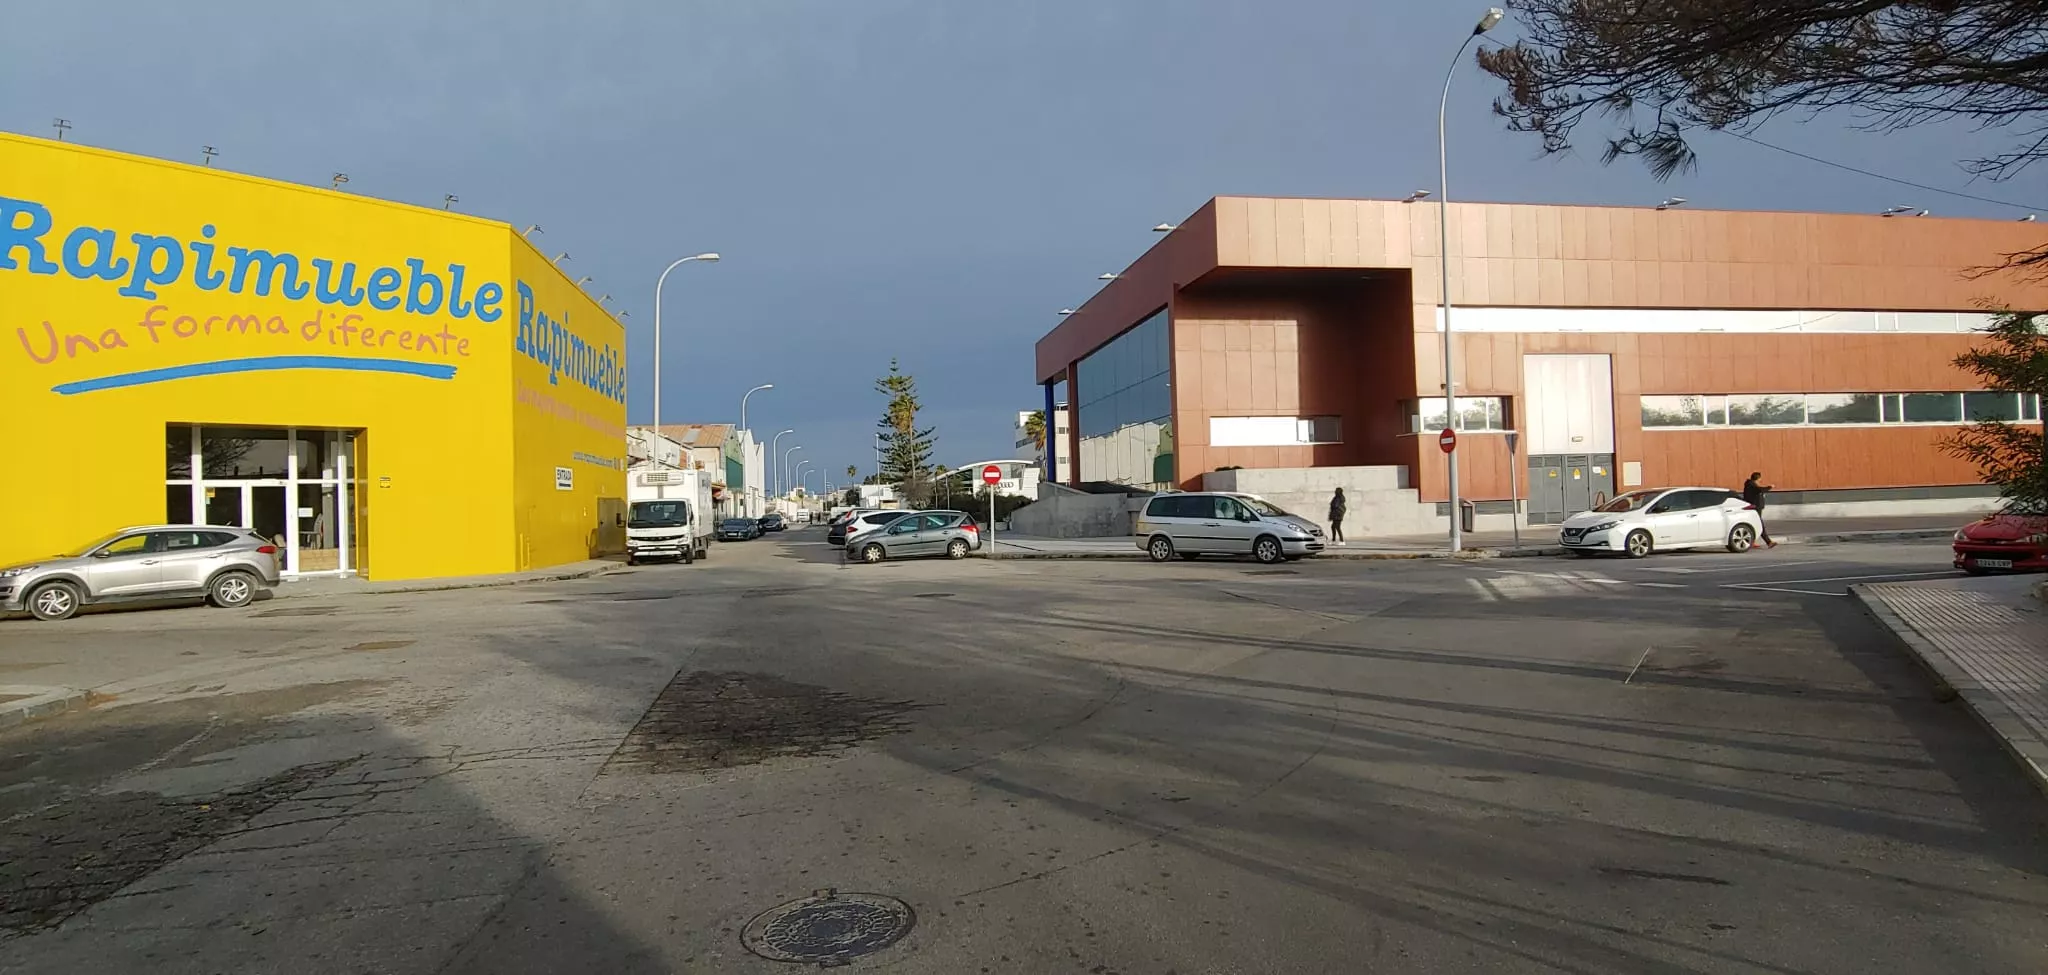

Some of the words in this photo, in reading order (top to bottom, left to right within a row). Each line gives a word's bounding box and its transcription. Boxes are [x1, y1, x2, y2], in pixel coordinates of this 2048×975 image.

[0, 195, 503, 322] Rapimueble
[17, 320, 128, 365] Una
[138, 304, 290, 345] forma
[300, 309, 471, 357] diferente
[516, 279, 625, 404] Rapimueble
